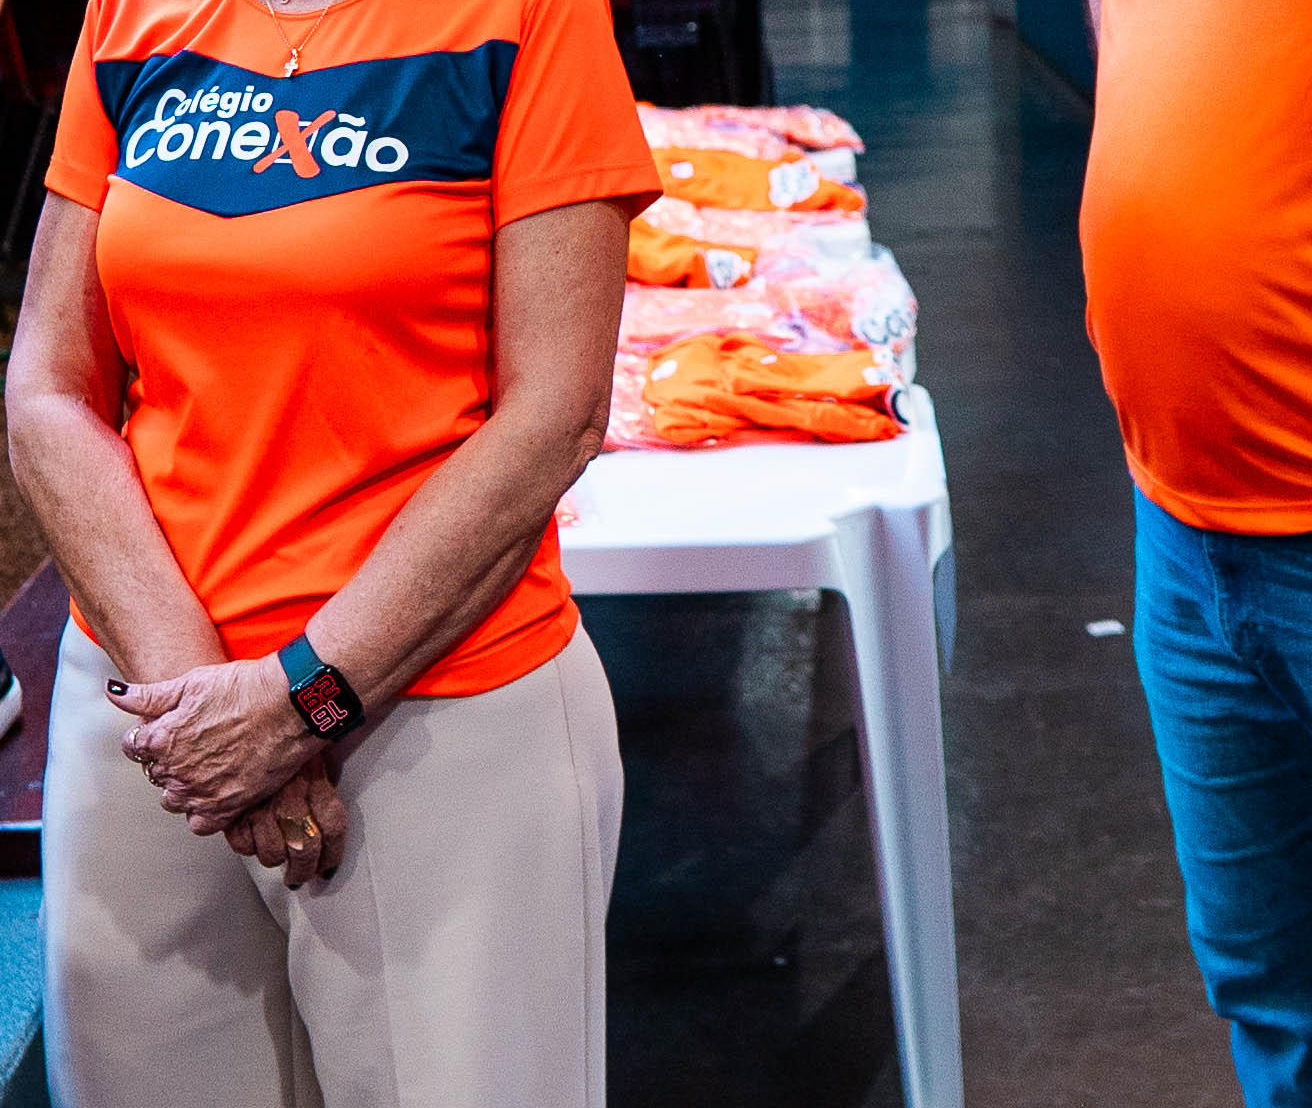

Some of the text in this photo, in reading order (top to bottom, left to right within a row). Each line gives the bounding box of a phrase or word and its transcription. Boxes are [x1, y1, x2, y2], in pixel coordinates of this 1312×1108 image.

[154, 85, 274, 122] Colégio
[298, 675, 340, 712] 29
[311, 701, 348, 731] 16
